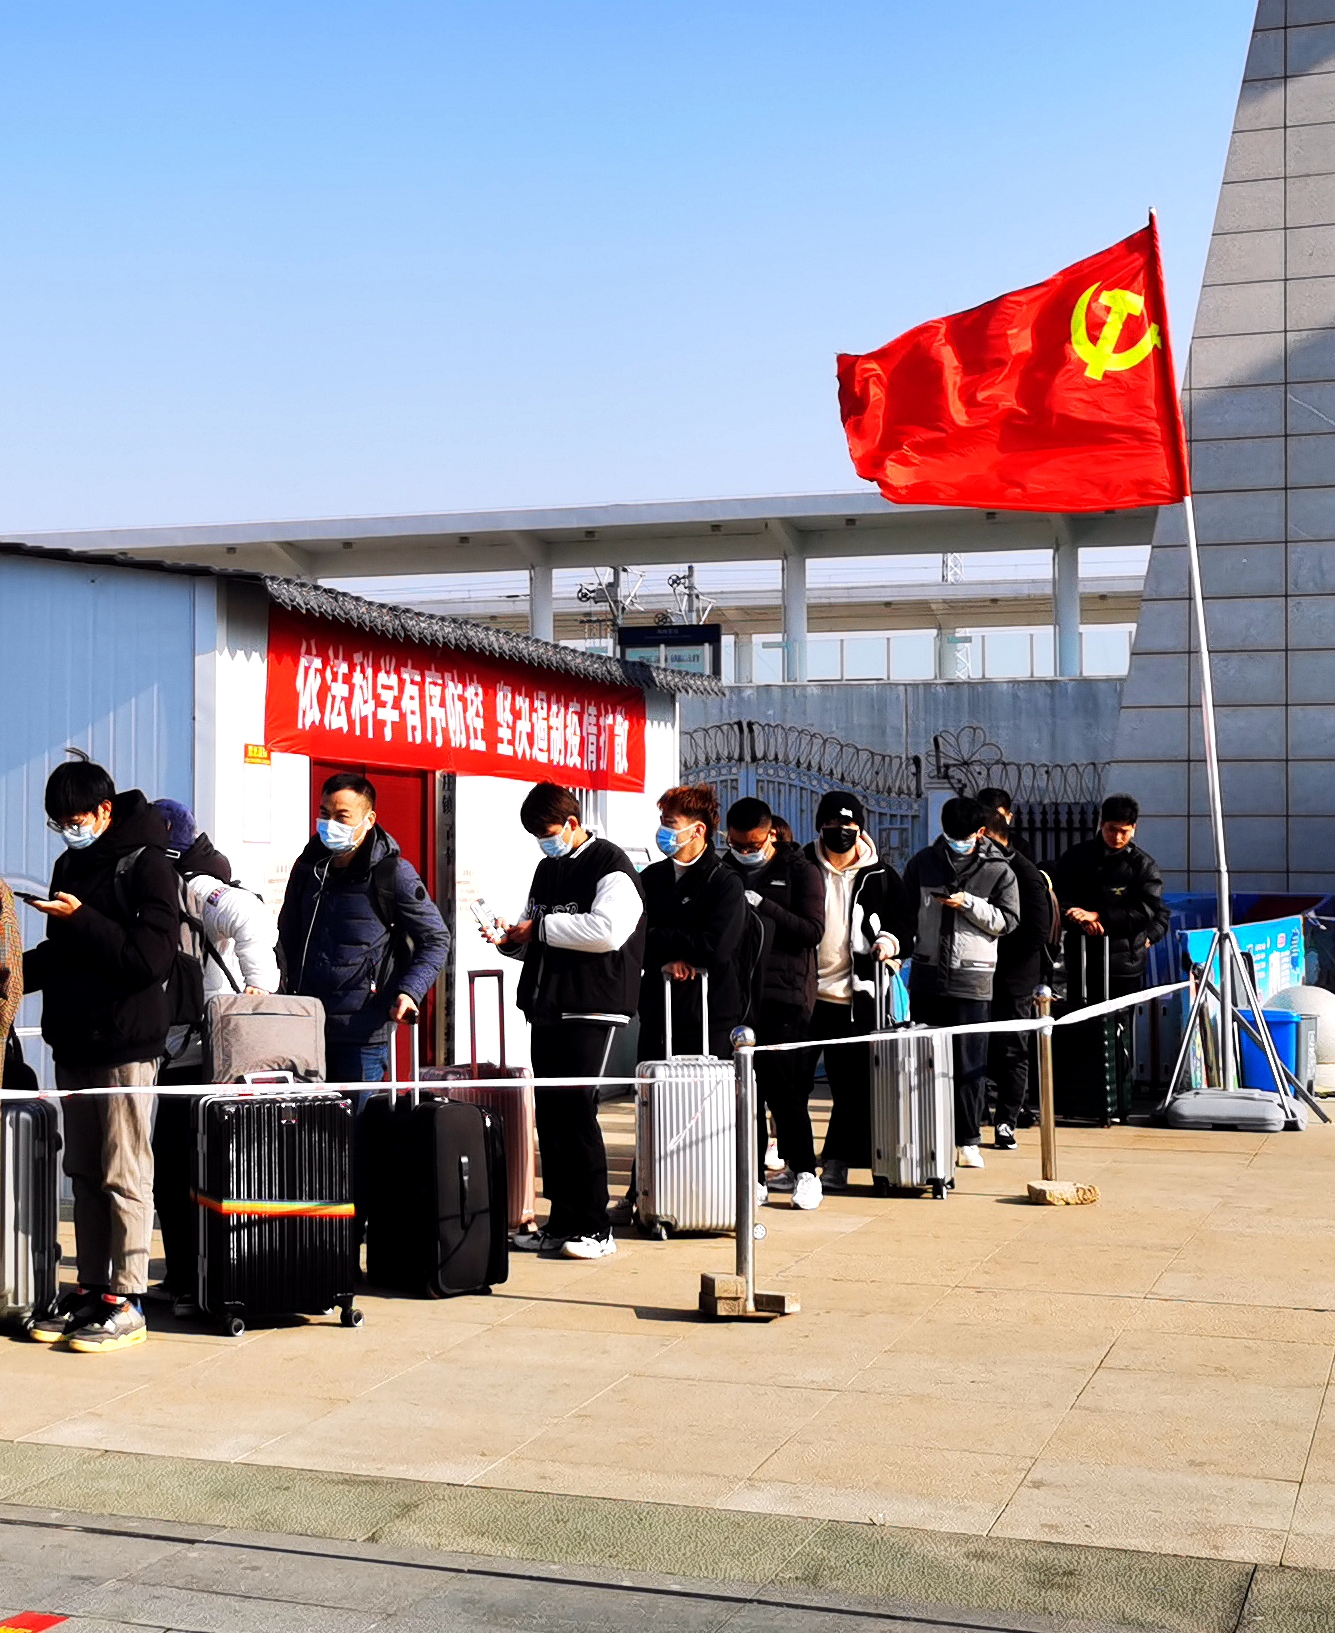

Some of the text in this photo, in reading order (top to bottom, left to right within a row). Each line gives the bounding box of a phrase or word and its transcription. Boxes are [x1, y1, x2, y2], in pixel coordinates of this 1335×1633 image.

[296, 638, 630, 775] 依法科学有序防控 坚决遏制疫情扩散
